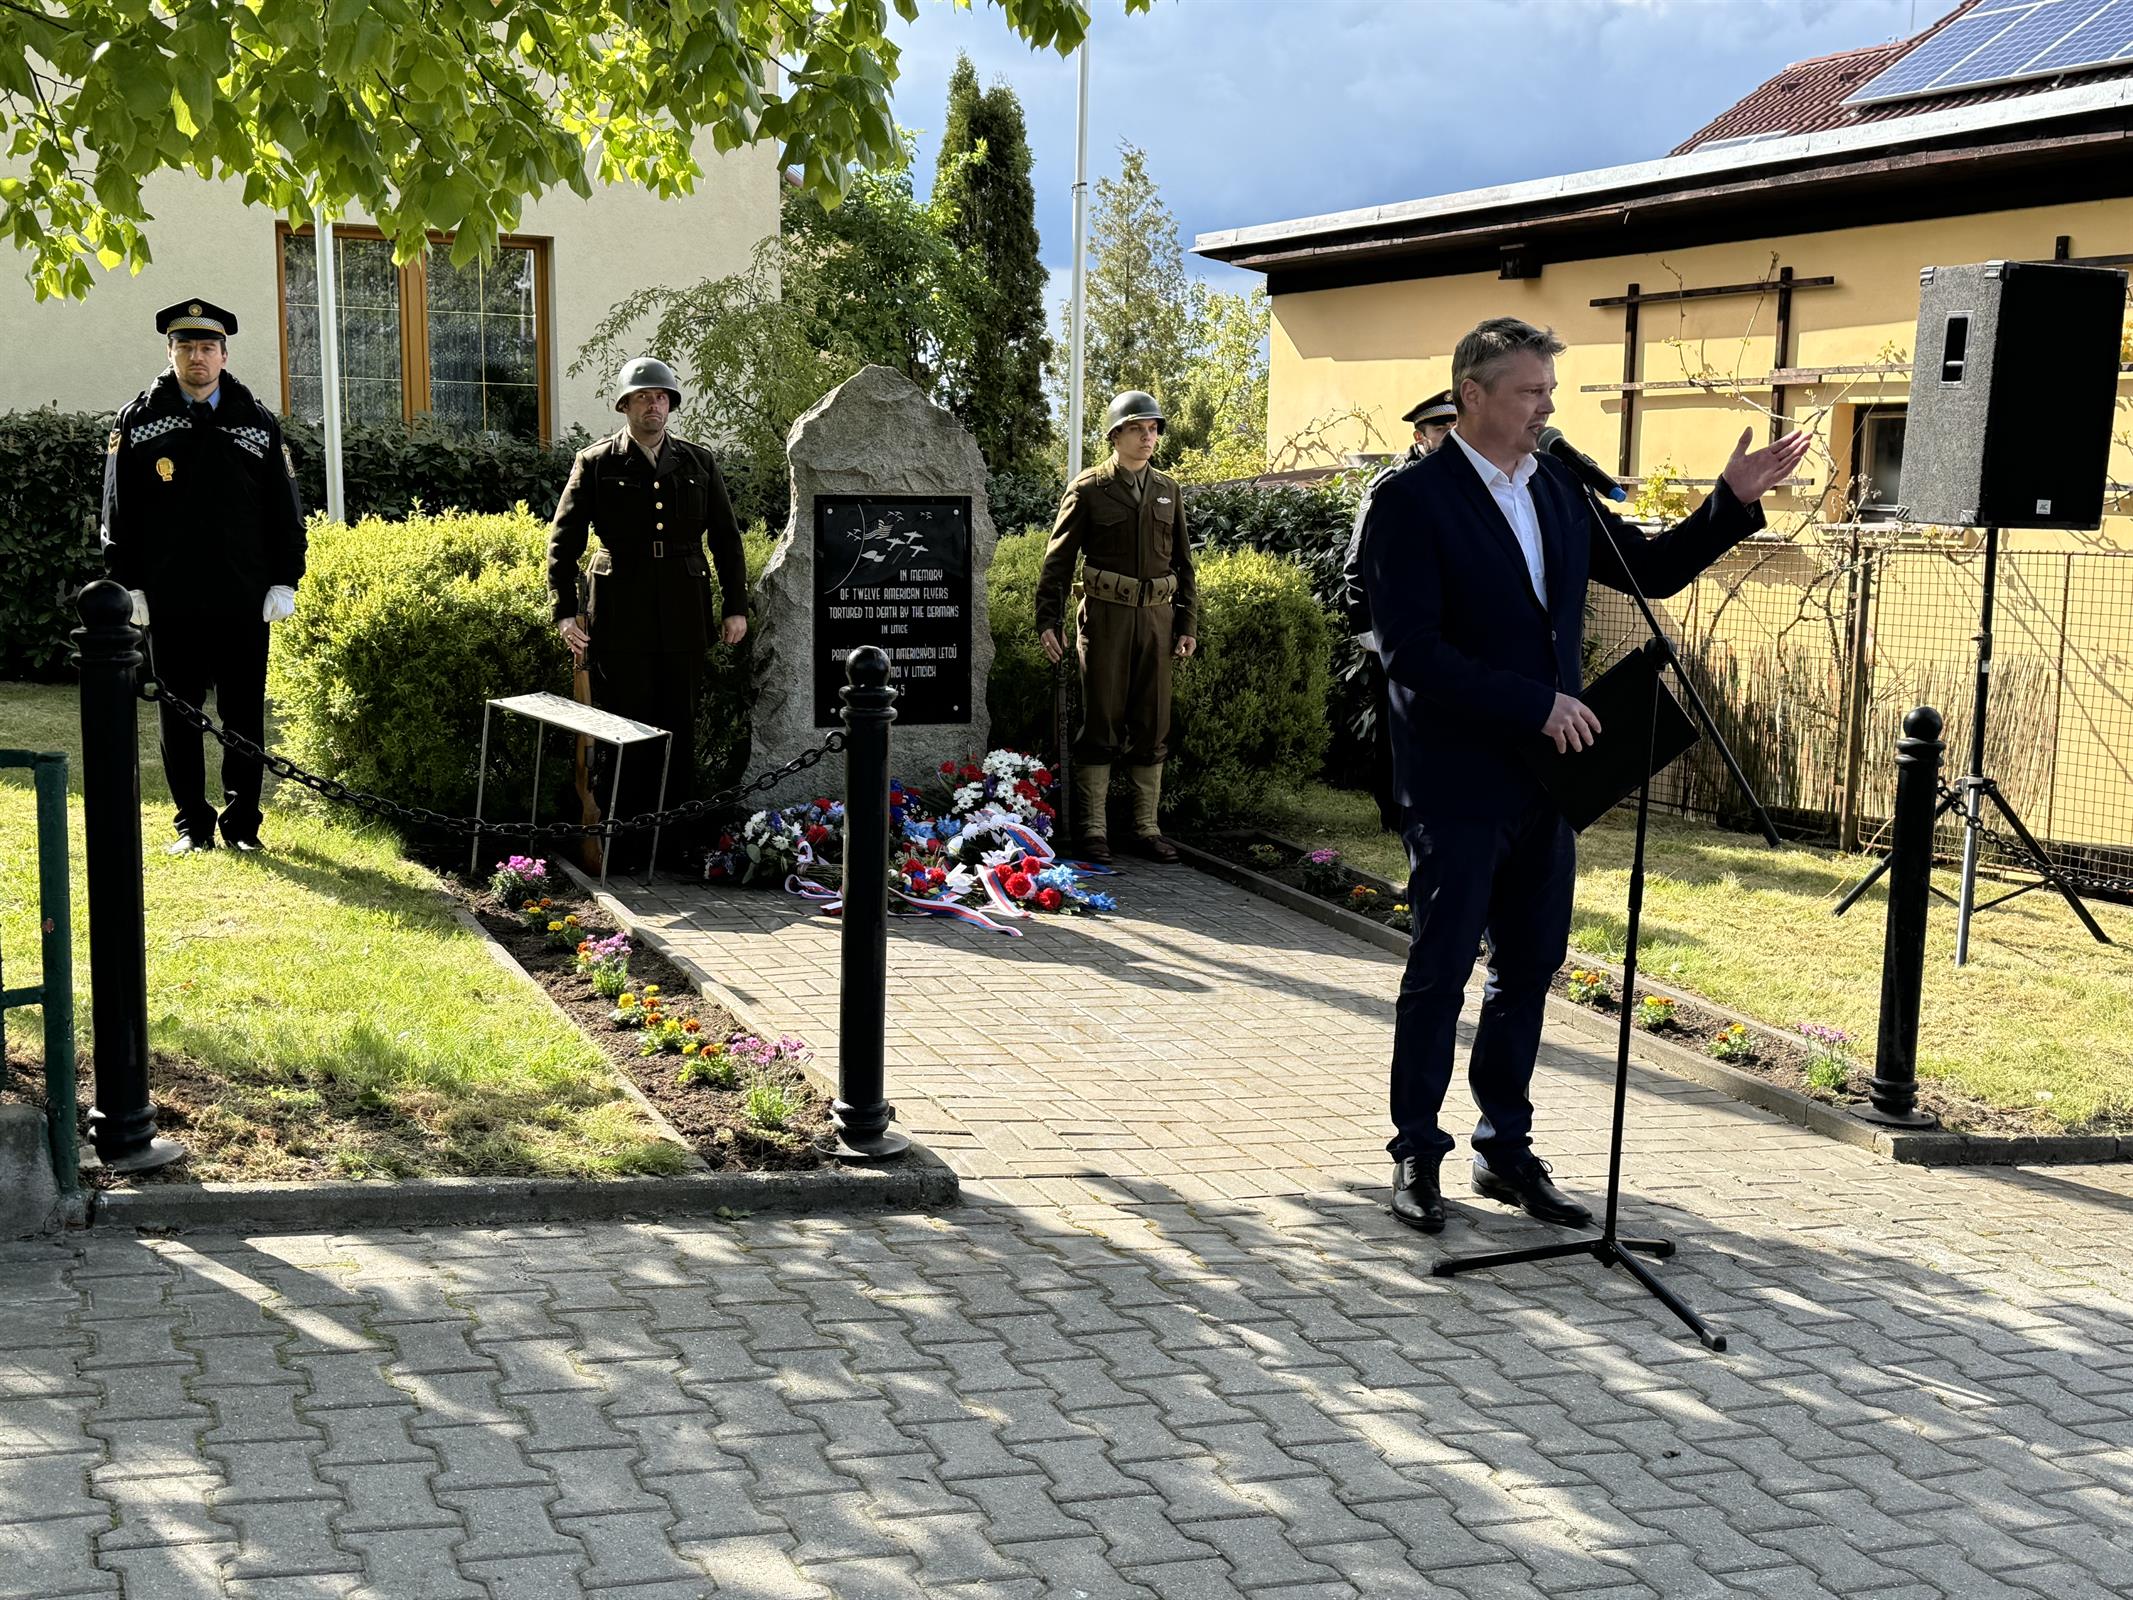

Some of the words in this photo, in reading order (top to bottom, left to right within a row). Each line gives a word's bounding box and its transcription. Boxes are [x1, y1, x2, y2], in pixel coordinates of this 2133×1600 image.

[233, 438, 264, 459] POLICE
[900, 569, 907, 582] IN
[910, 569, 943, 581] MEMORY
[840, 588, 849, 600] OF
[853, 588, 880, 600] TWELVE
[884, 588, 920, 600] AMERICAN
[923, 587, 949, 599] FLYERS
[829, 606, 863, 619] TORTURED
[865, 606, 874, 619] TO
[876, 606, 898, 618] DEATH
[900, 606, 909, 618] BY
[912, 606, 924, 618] THE
[926, 605, 959, 618] GERMANS
[881, 624, 889, 634] IN
[895, 643, 936, 660] AMERICKÝCH
[904, 665, 909, 678] V
